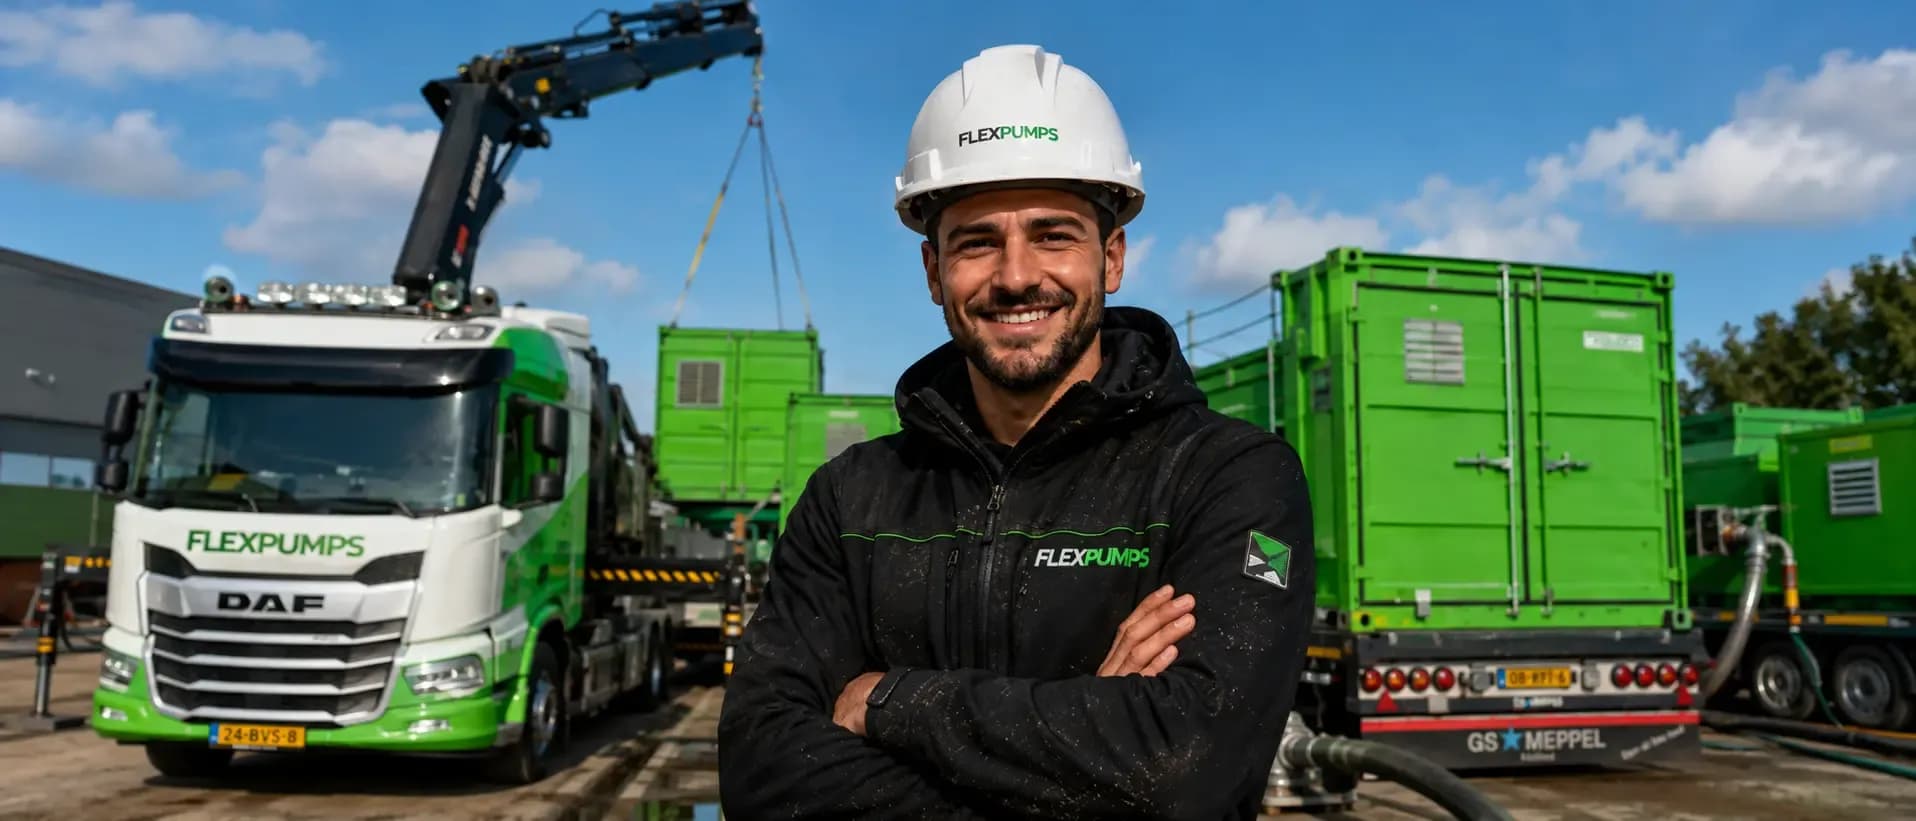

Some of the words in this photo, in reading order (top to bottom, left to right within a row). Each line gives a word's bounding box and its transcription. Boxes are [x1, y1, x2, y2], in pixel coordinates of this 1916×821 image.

[959, 126, 1059, 147] FLEXPUMPS
[187, 530, 365, 557] FLEXPUMPS
[1034, 547, 1150, 568] FLEXPUMPS
[217, 592, 325, 613] DAF
[223, 727, 297, 744] 24-BVS-8
[1467, 731, 1499, 752] GS
[1524, 728, 1607, 751] MEPPEL
